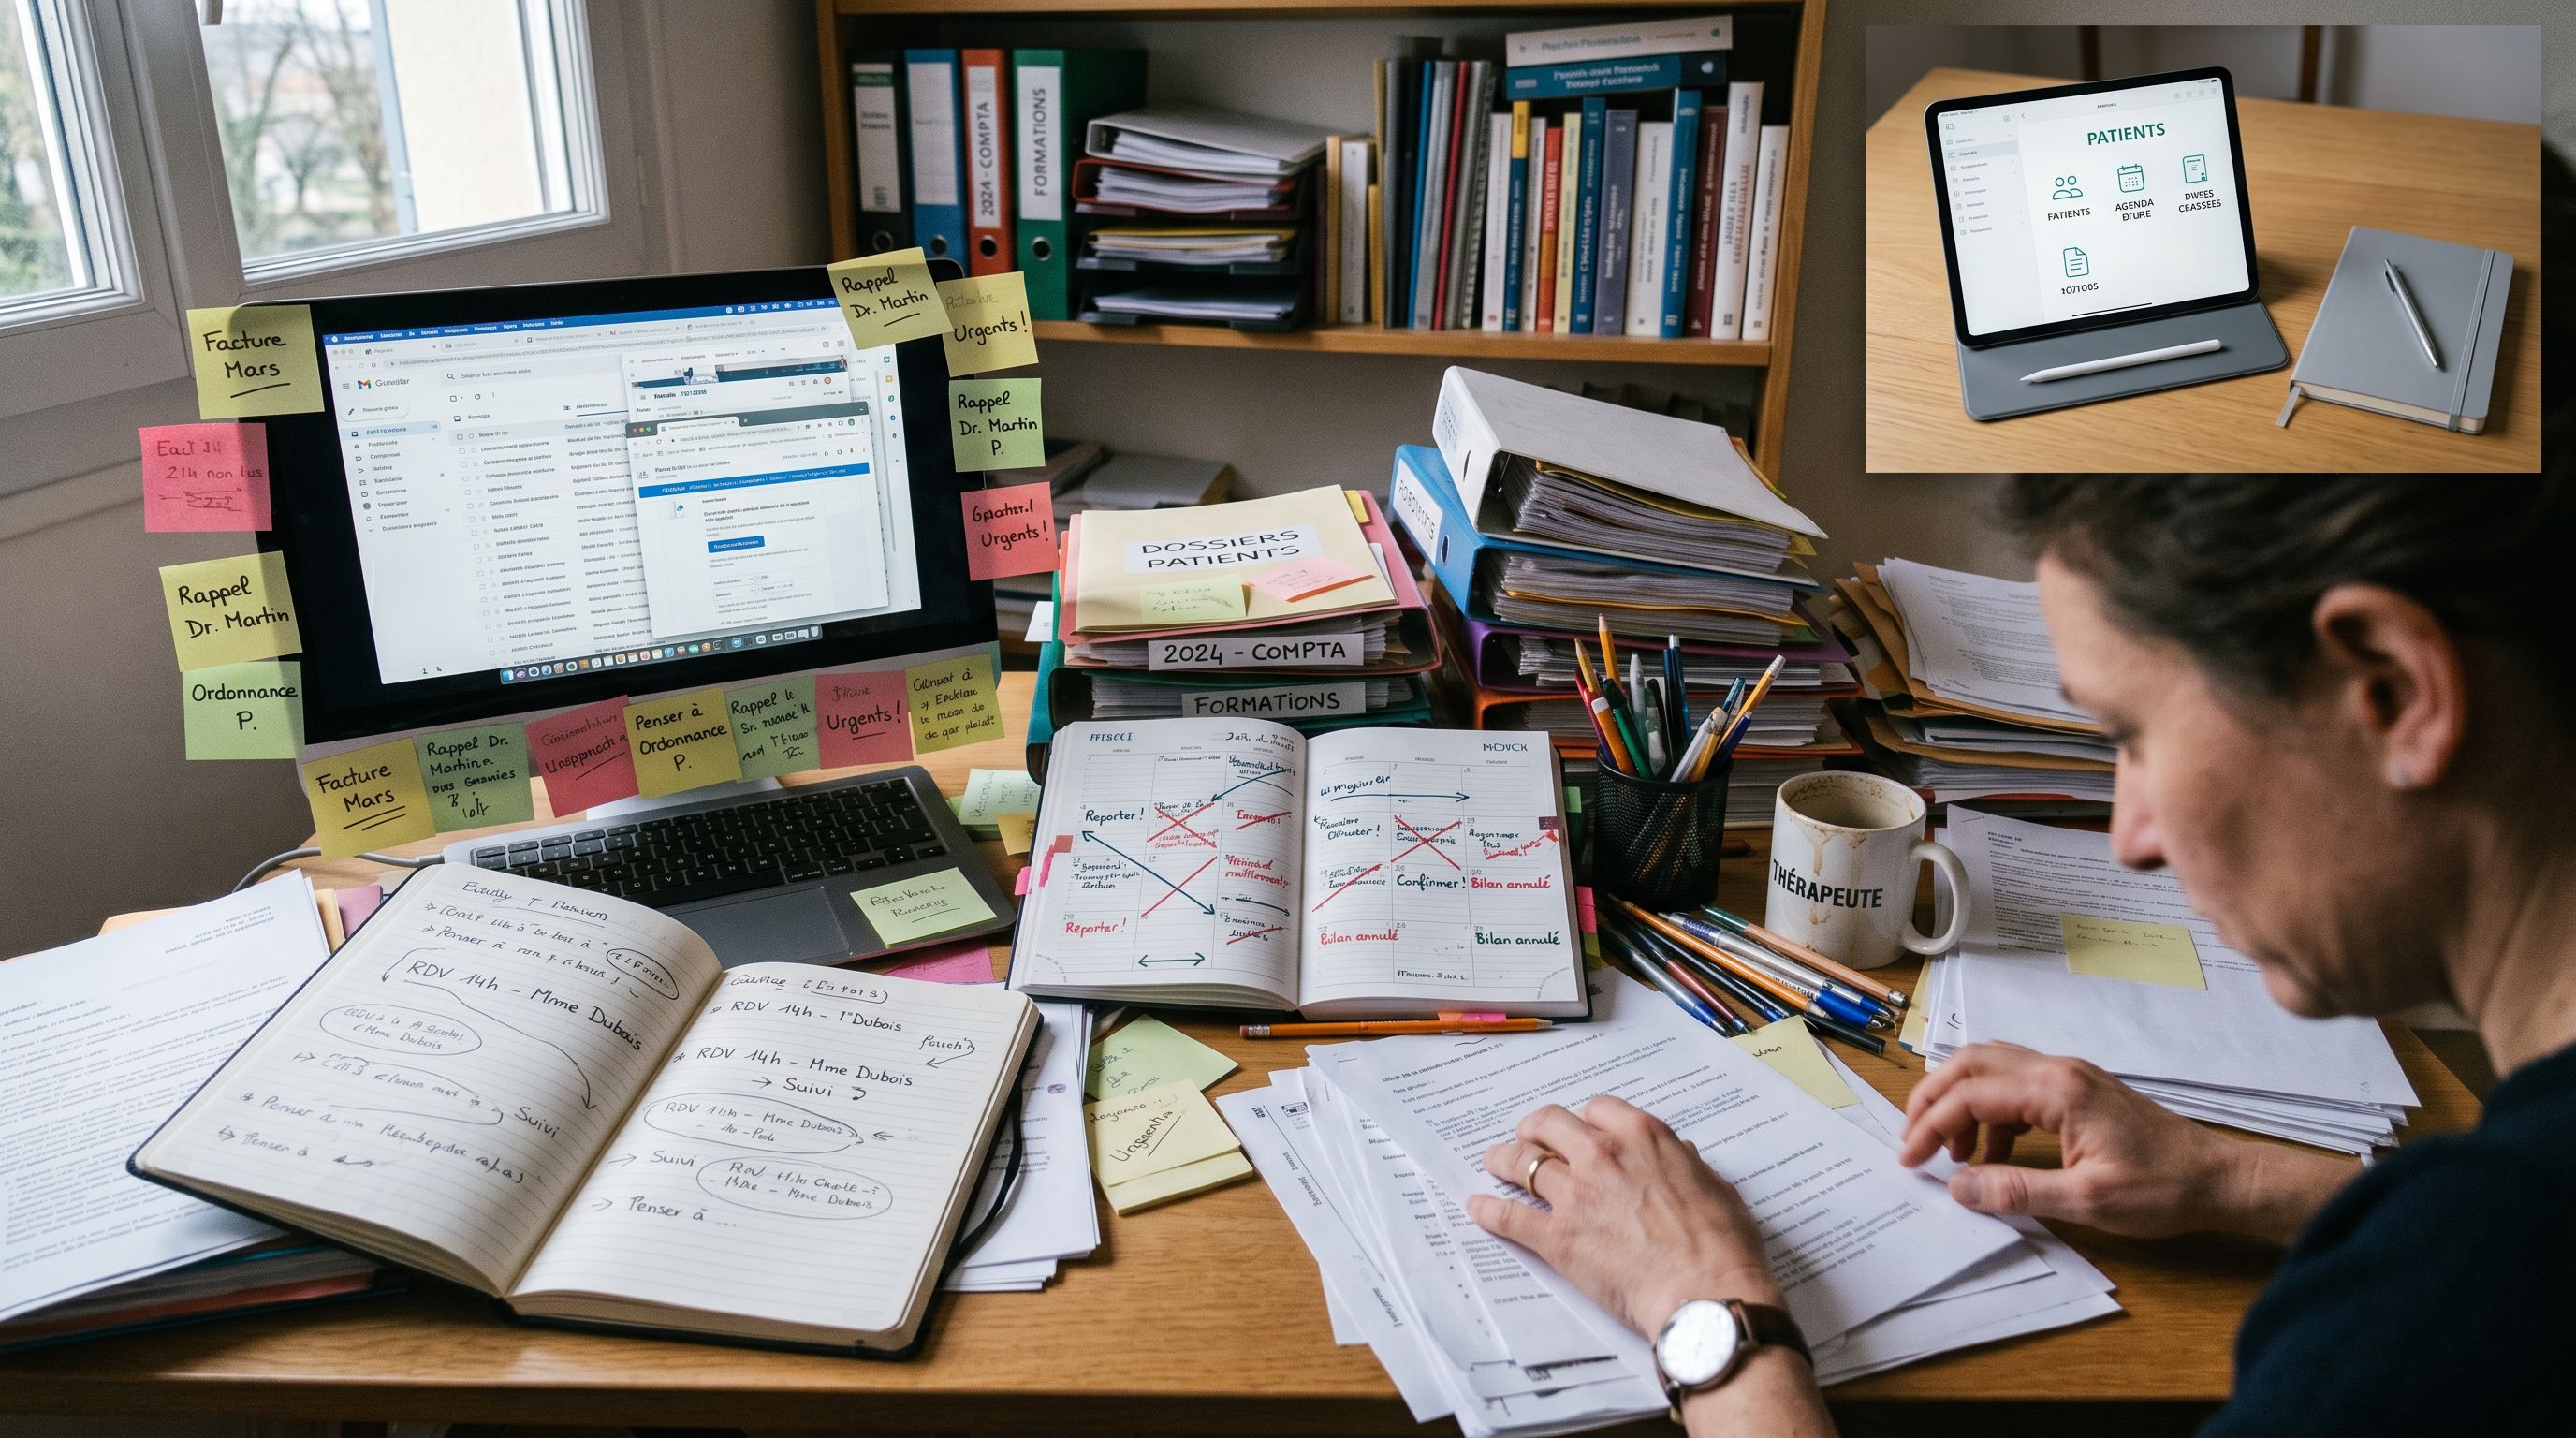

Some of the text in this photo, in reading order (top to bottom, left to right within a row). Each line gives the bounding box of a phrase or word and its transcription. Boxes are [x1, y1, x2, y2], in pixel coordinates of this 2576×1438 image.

[977, 102, 993, 169] COMPTA
[1032, 88, 1047, 197] FORMATIONS
[2087, 123, 2166, 146] PATIENTS
[2115, 199, 2154, 212] AGENDA
[842, 267, 898, 294] Rappel
[850, 302, 877, 318] Dr.
[879, 289, 929, 314] Martin
[203, 330, 286, 352] Facture
[225, 360, 280, 379] Mars
[958, 390, 1011, 416] Rappel
[959, 418, 1038, 436] Dr. Martin
[1142, 529, 1300, 554] DOSSIERS
[1148, 545, 1300, 568] PATIENTS
[178, 575, 253, 608] Rappel
[185, 606, 290, 638] Dr. Martin
[1164, 644, 1224, 666] 2024
[192, 683, 299, 702] Ordonnance
[731, 692, 777, 717] Rappel
[236, 711, 257, 730] P.
[635, 711, 684, 731] Penser
[426, 735, 509, 758] Rappel Dr.
[639, 724, 728, 756] Ordonnance
[673, 754, 693, 771] P.
[315, 764, 392, 795] Facture
[343, 788, 396, 813] Mars
[1471, 874, 1551, 888] Bilan annulé
[1773, 858, 1883, 909] THÉRAPEUTE
[1355, 929, 1399, 941] annulé
[1475, 931, 1561, 946] Bilan annulé
[407, 961, 455, 978] RDV
[459, 973, 499, 992] 14h
[530, 987, 579, 1015] Mme
[589, 1005, 643, 1052] Dubois
[731, 1001, 770, 1012] RDV
[778, 1004, 812, 1018] 14h
[696, 1047, 737, 1060] RDV
[744, 1050, 782, 1065] 14h
[810, 1058, 848, 1077] Mme
[856, 1065, 914, 1087] Dubois
[783, 1078, 833, 1097] Suivi
[514, 1106, 561, 1138] Suivi
[650, 1150, 696, 1167] Suivi
[630, 1196, 681, 1217] Penser
